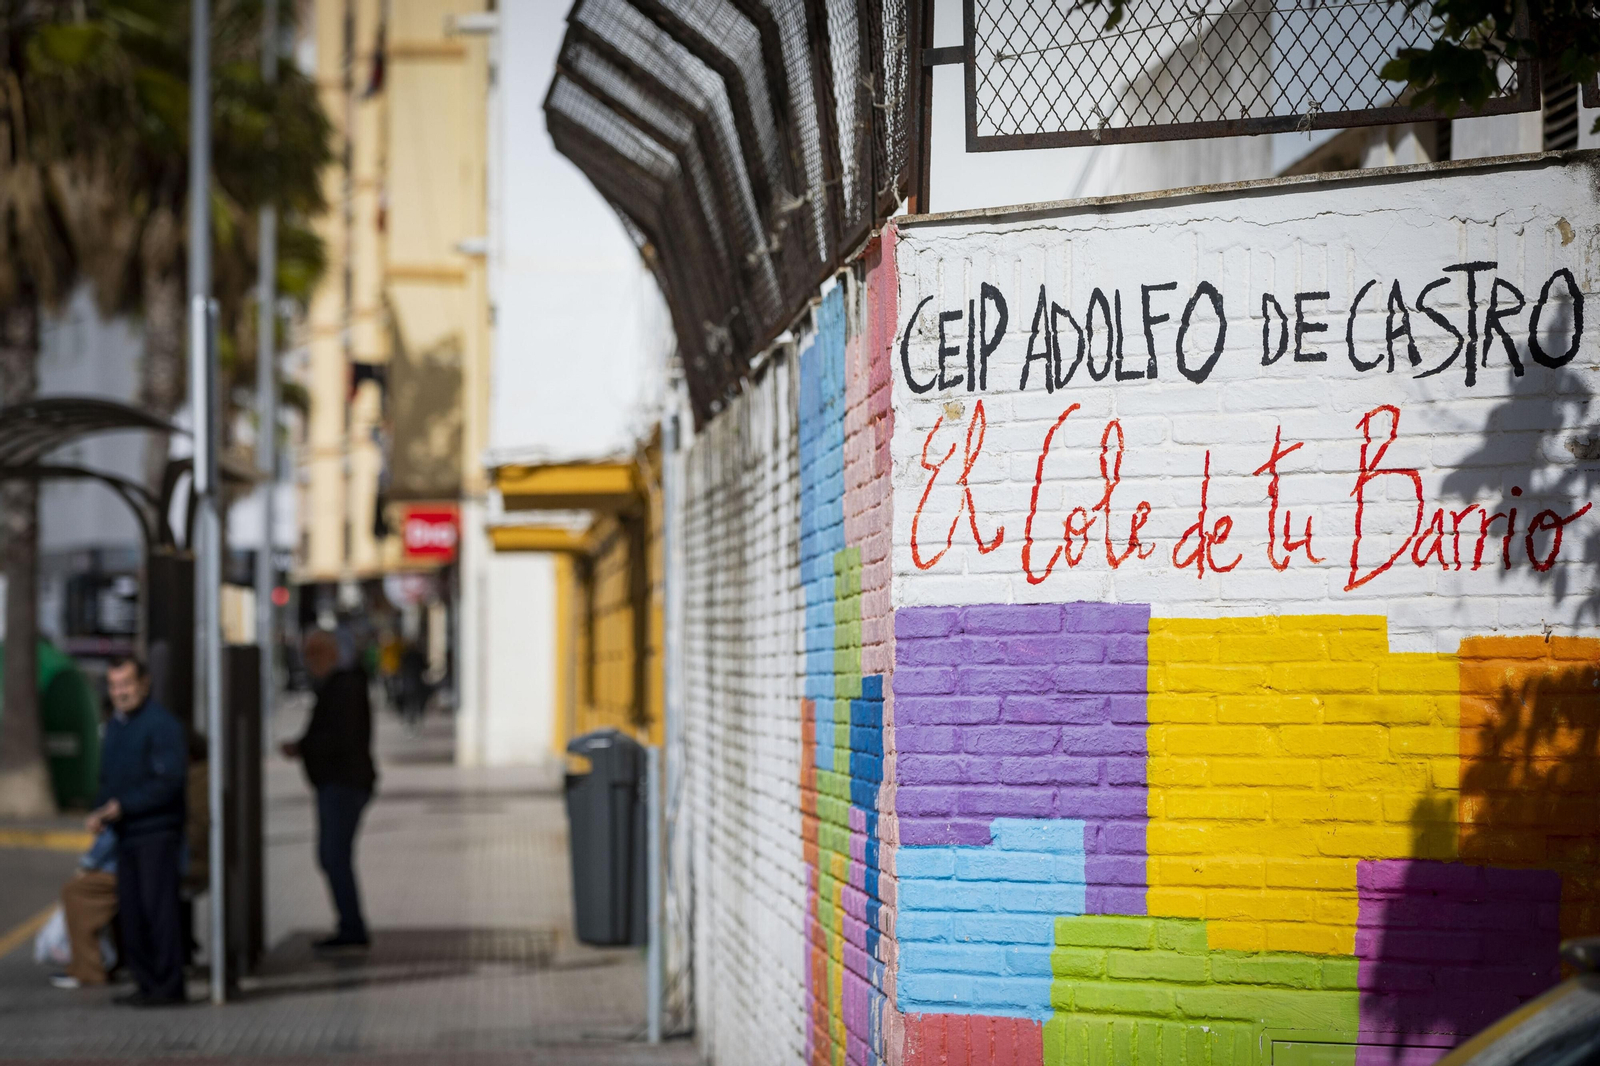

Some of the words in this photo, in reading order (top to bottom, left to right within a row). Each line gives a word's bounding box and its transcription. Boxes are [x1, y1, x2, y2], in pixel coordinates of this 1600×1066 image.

[900, 281, 1009, 394] CEIP
[1019, 280, 1228, 395] ADOLFO
[1260, 291, 1331, 367] DE
[1346, 260, 1585, 388] CASTRO
[910, 400, 1005, 571] El
[1021, 402, 1157, 586] Cole
[1172, 450, 1243, 580] de
[1252, 424, 1327, 572] tu
[1343, 403, 1593, 593] Barrio
